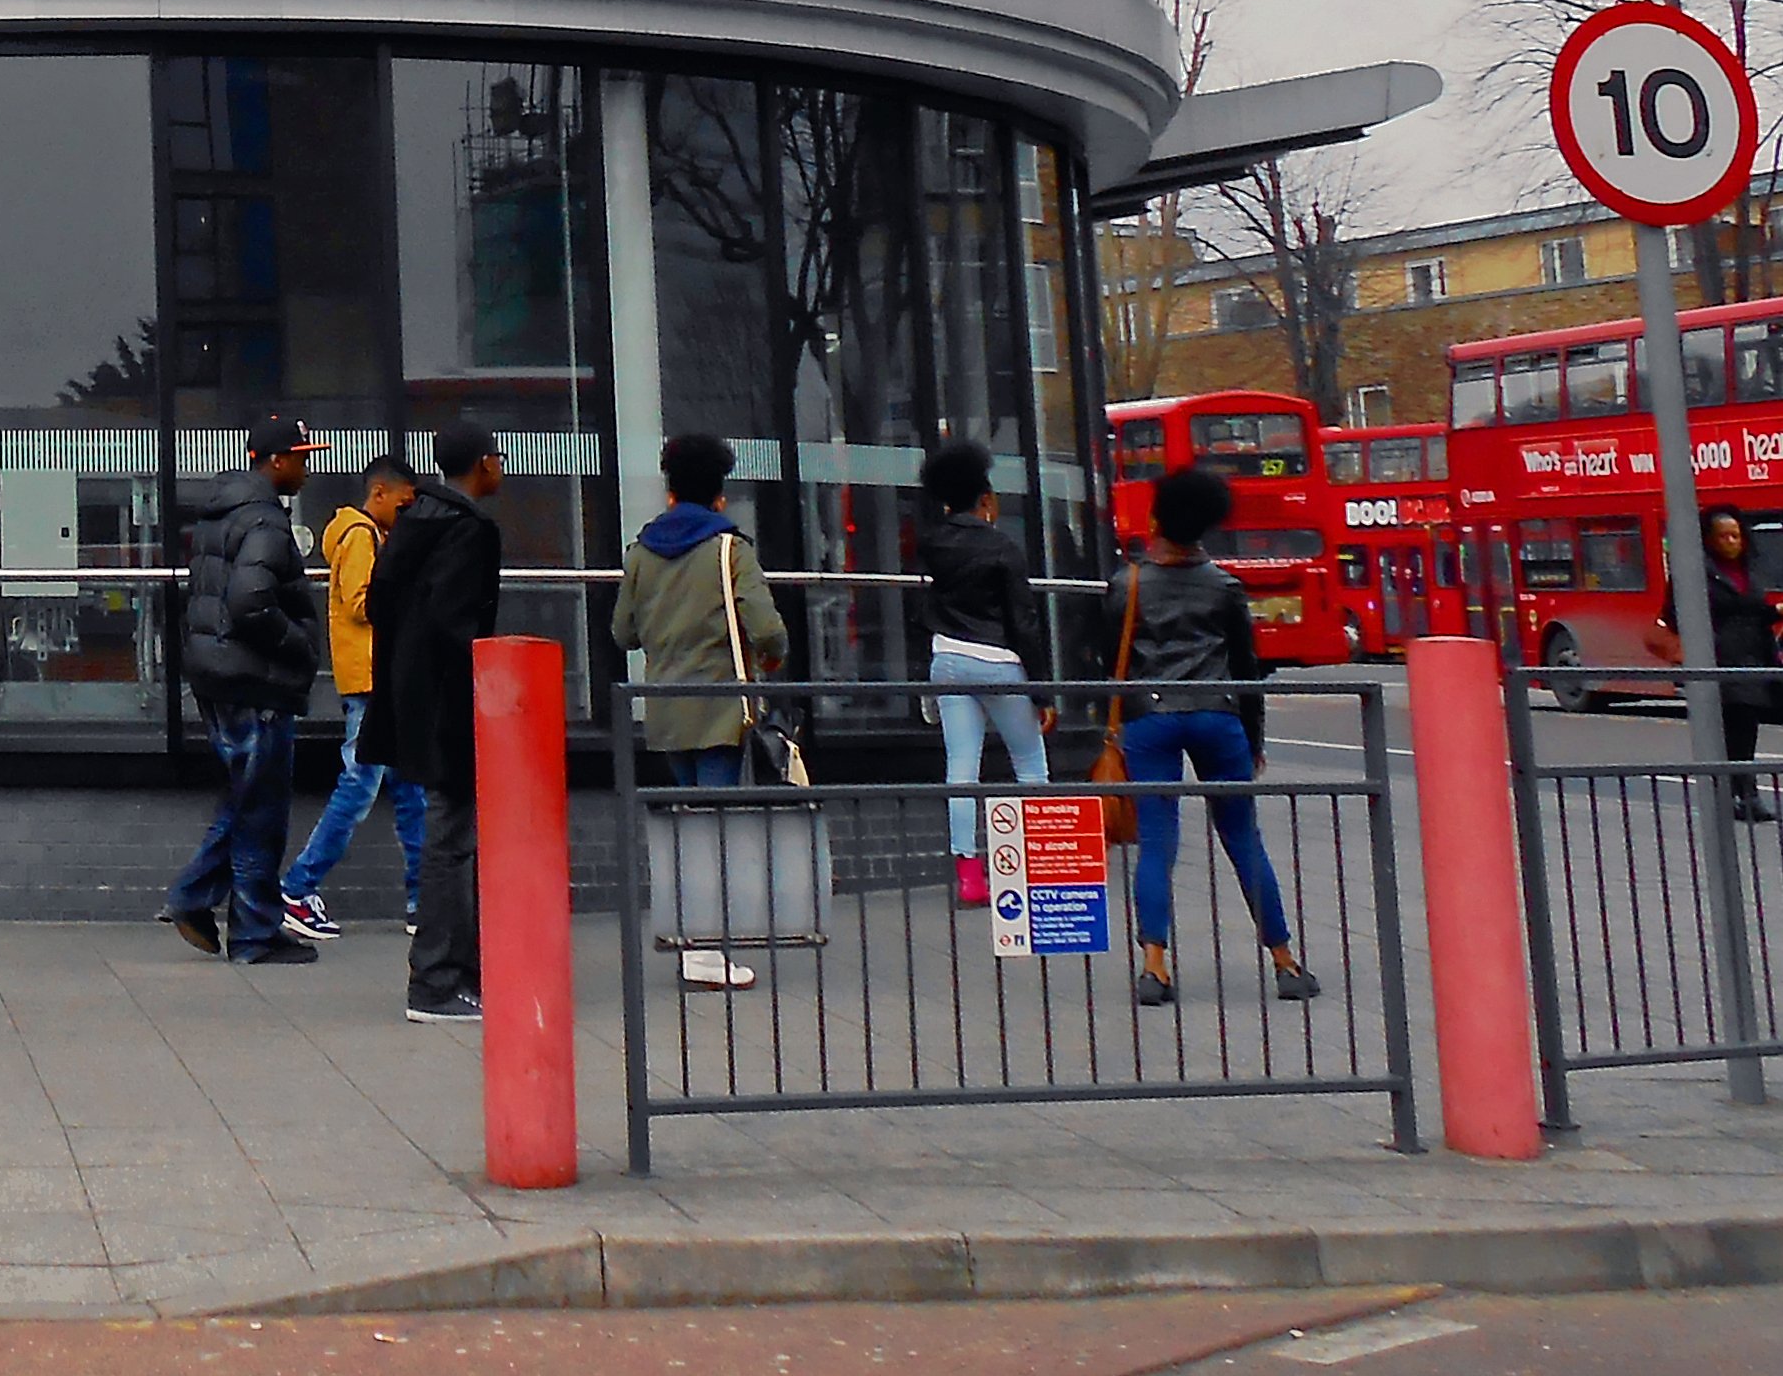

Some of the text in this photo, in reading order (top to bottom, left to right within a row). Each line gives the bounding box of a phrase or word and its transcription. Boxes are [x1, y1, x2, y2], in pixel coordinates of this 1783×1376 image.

[1597, 68, 1710, 159] 10
[1578, 446, 1619, 476] heart
[1025, 805, 1040, 814] No
[1028, 842, 1042, 851] No
[1030, 889, 1058, 901] CCTV
